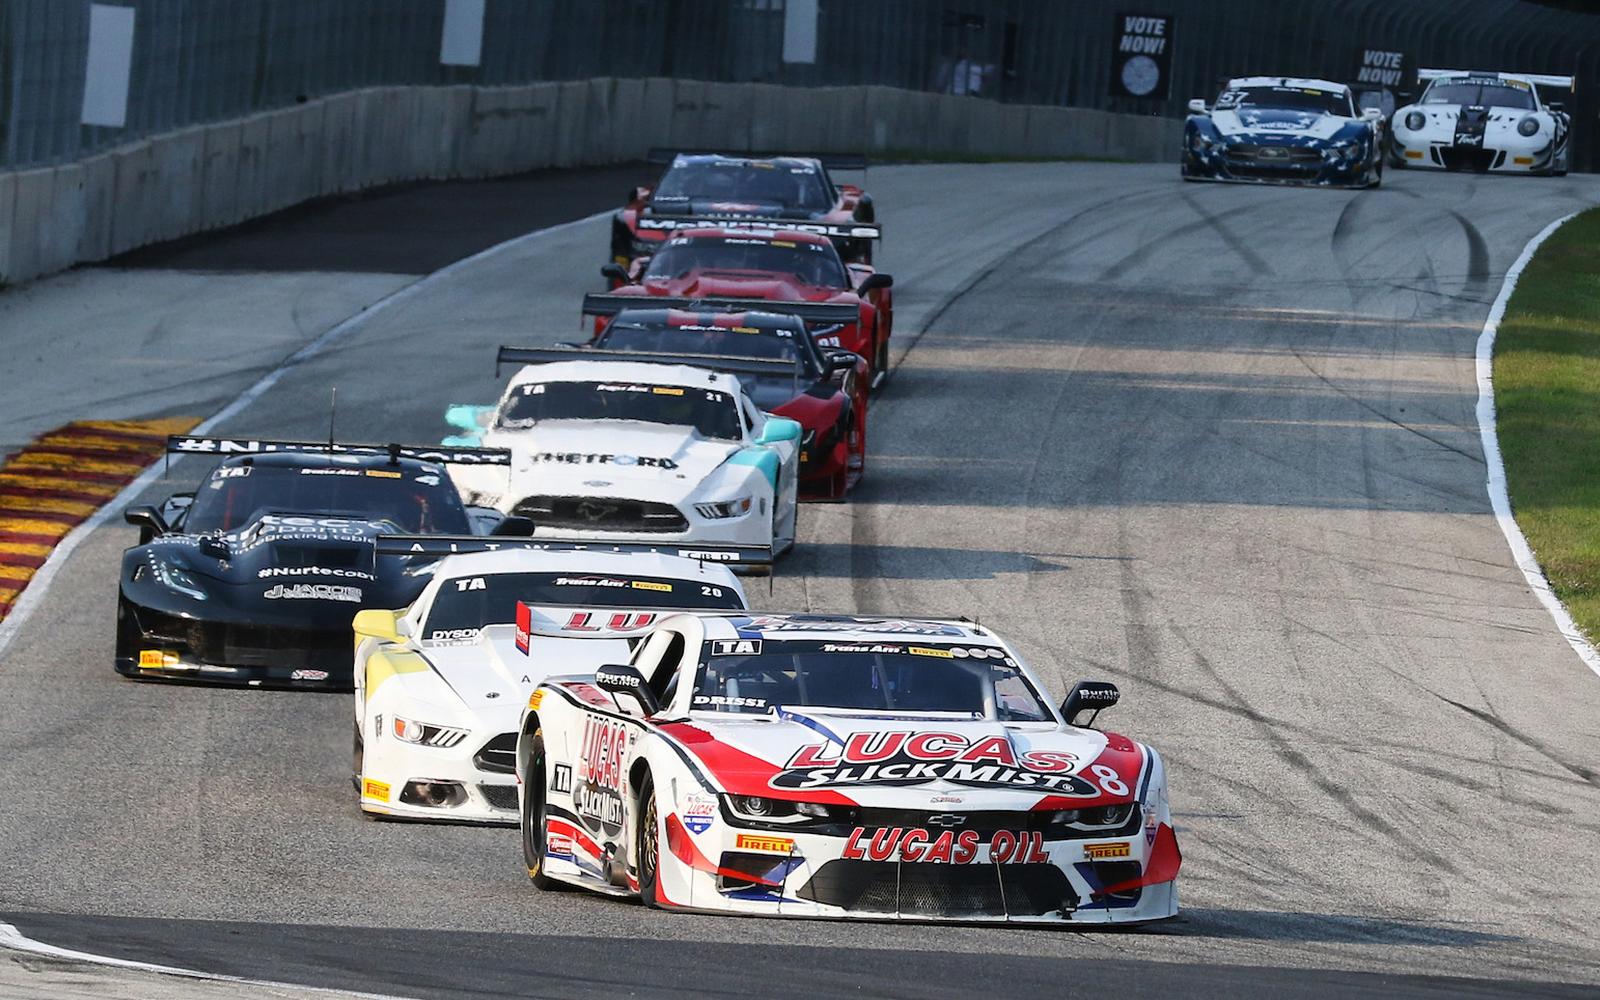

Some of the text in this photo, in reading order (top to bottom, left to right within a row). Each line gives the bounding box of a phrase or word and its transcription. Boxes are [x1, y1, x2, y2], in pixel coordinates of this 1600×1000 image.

[1125, 16, 1166, 35] VOTE
[1119, 34, 1166, 54] NOW!
[1364, 50, 1403, 68] VOTE
[1358, 66, 1402, 86] NOW!
[1219, 91, 1249, 103] 57
[706, 392, 722, 402] 21
[530, 452, 679, 470] THETFORD
[456, 577, 487, 592] TA
[555, 577, 625, 588] Trans Am
[701, 585, 723, 598] 20
[432, 628, 481, 640] DYSON
[718, 640, 757, 654] TA
[822, 644, 901, 655] Trans Am
[693, 694, 767, 709] DRISSI
[580, 713, 627, 793] LUCAS
[784, 730, 1081, 775] LUCAS
[556, 766, 572, 793] TA
[1091, 764, 1131, 797] 8
[687, 803, 715, 816] LUCAS
[736, 833, 794, 853] PIRELLI
[841, 827, 1052, 865] LUCAS OIL
